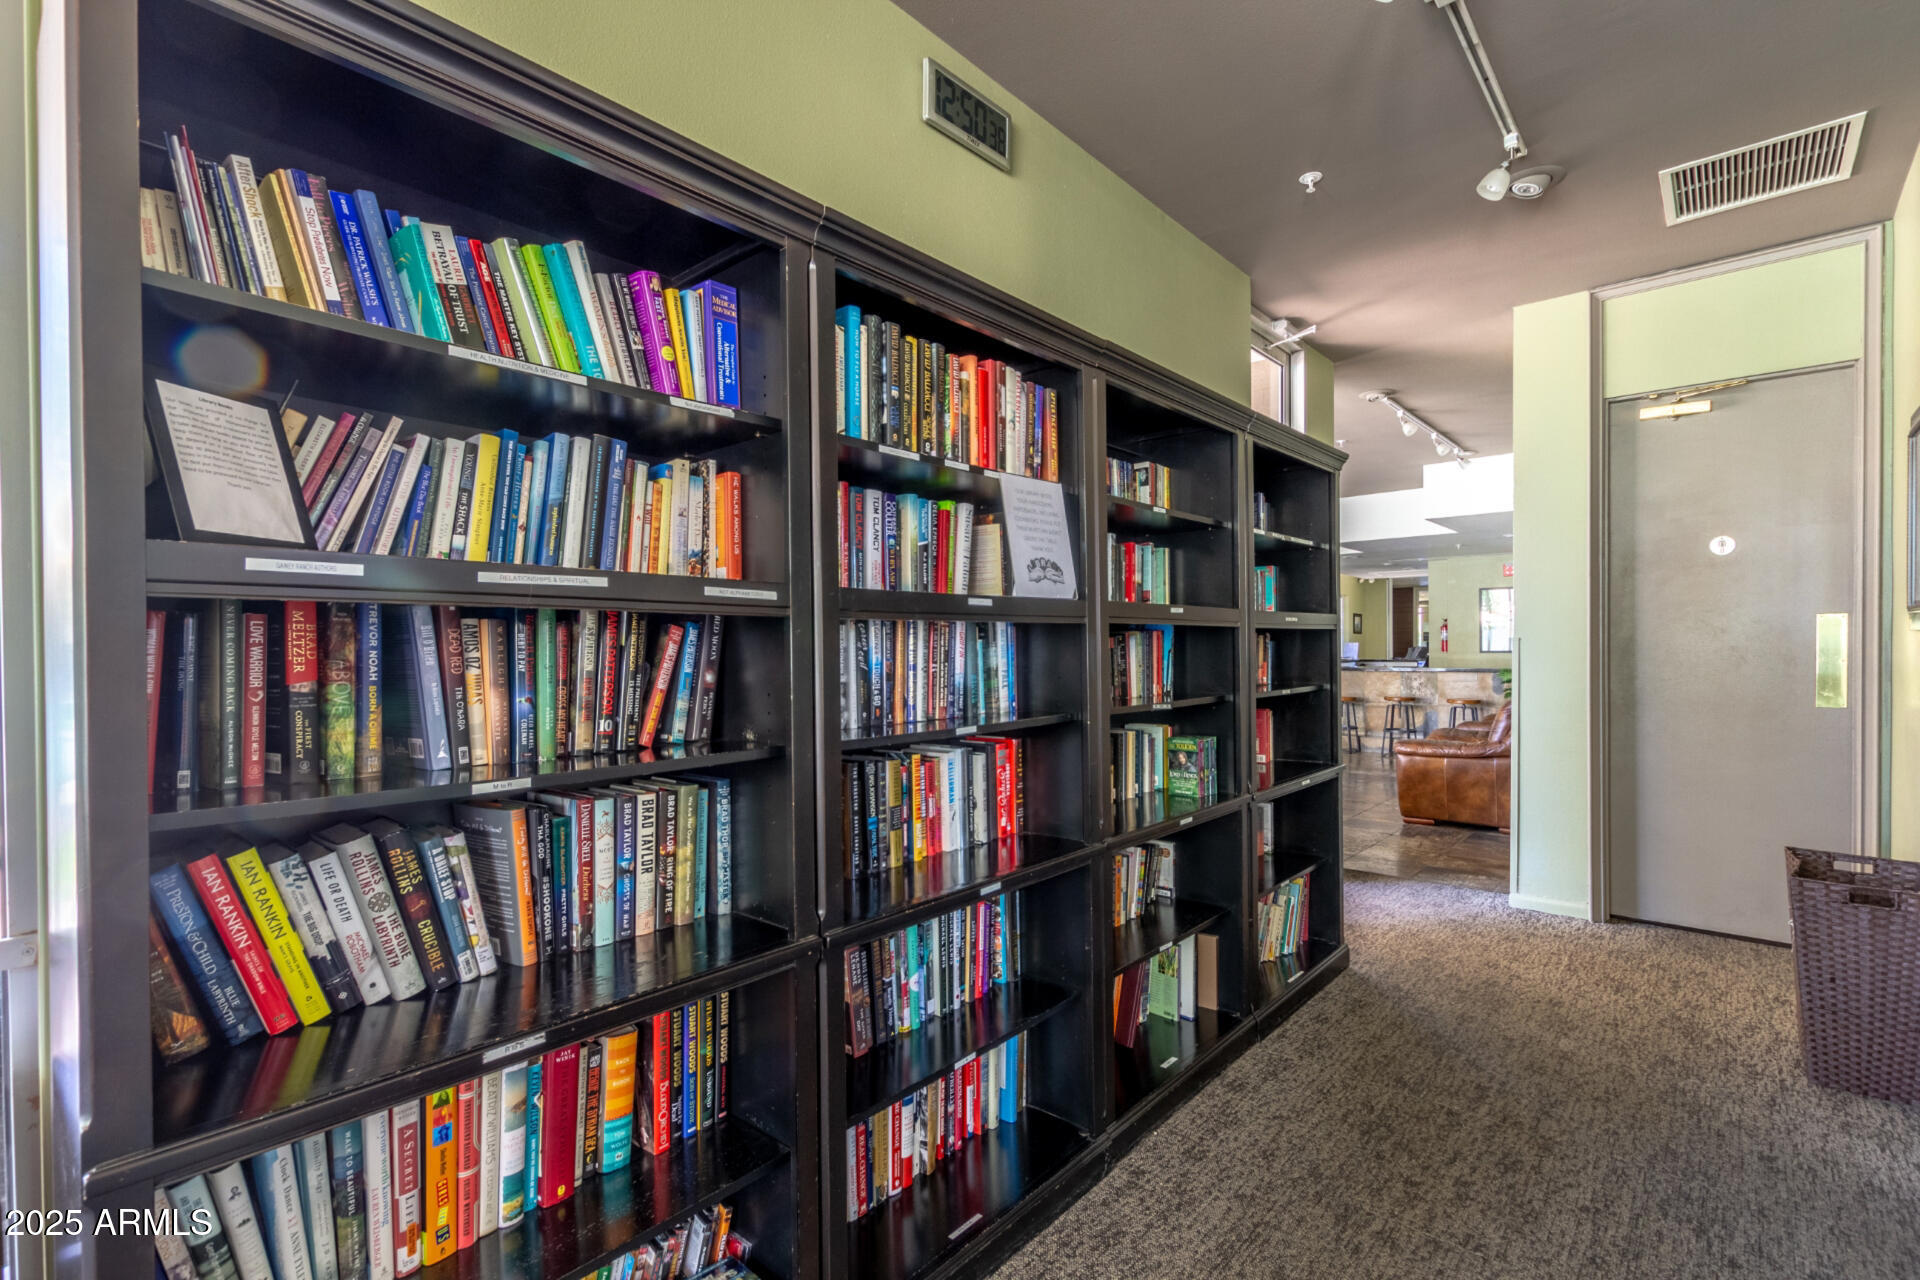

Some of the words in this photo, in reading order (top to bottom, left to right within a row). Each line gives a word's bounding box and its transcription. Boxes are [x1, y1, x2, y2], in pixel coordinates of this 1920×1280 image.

[235, 159, 261, 219] AfterShock
[304, 207, 316, 229] Stop
[321, 265, 333, 289] Now
[353, 236, 368, 269] PATRICK
[360, 270, 379, 307] WALSH'S
[432, 230, 454, 284] BETRAYAL
[452, 299, 469, 335] TRUST
[711, 294, 737, 310] MEDICAL
[711, 304, 738, 318] ADVISOR
[716, 321, 724, 362] Conventional
[469, 351, 498, 364] HEALTH
[499, 358, 533, 372] NUTRITION
[539, 366, 570, 380] MEDICINE
[723, 341, 731, 377] Alternative
[891, 349, 899, 386] BALDACCI
[718, 363, 726, 401] Treatments
[924, 370, 932, 412] BALDACCI
[464, 452, 475, 481] YOUNG
[732, 488, 740, 515] WALKS
[856, 494, 864, 513] TOM
[872, 496, 880, 515] TOM
[884, 500, 892, 536] COULTER
[456, 504, 469, 536] SHACK
[733, 517, 741, 543] AMONG
[856, 514, 864, 550] CLANCY
[872, 516, 880, 553] CLANCY
[499, 574, 553, 584] RELATIONSHIPS
[558, 577, 590, 586] SPIRITUAL
[224, 605, 235, 639] NEVER
[249, 620, 264, 644] LOVE
[368, 602, 378, 648] TREVOR
[462, 623, 481, 653] AMOS
[605, 611, 619, 648] JAMES
[291, 610, 305, 673] MELTZER
[304, 623, 316, 660] BRAD
[517, 633, 526, 650] DEBT
[224, 642, 236, 684] COMING
[248, 645, 264, 689] WARRIOR
[368, 650, 378, 681] NOAH
[465, 655, 482, 670] OZ
[496, 625, 505, 693] WARLIGHT
[602, 648, 618, 716] PATTERSON
[873, 663, 881, 690] TOUCH
[225, 686, 236, 712] BACK
[368, 685, 377, 709] BORN
[633, 687, 641, 722] PRESIDENT
[294, 710, 304, 759] CONSPIRACY
[367, 718, 377, 750] CRIME
[599, 719, 613, 732] 10
[580, 803, 592, 839] DANIELLE
[623, 803, 632, 826] BRAD
[641, 798, 655, 830] BRAD
[667, 795, 675, 818] BRAD
[721, 798, 729, 823] BRAD
[581, 840, 591, 862] STEEL
[623, 828, 631, 859] TAYLOR
[666, 820, 675, 852] TAYLOR
[721, 824, 729, 849] THOR
[363, 852, 385, 886] JAMES
[402, 850, 423, 885] JAMES
[434, 856, 450, 881] BRIEF
[640, 833, 654, 875] TAYLOR
[320, 862, 334, 882] LIFE
[349, 852, 376, 896] ROLLINS
[388, 848, 413, 896] ROLLINS
[582, 866, 592, 901] Duchess
[240, 860, 262, 886] IAN
[252, 887, 287, 941] RANKIN
[328, 883, 342, 897] OR
[441, 879, 457, 901] STOP
[200, 866, 225, 894] IAN
[214, 895, 252, 949] RANKIN
[333, 896, 353, 923] DEATH
[387, 912, 402, 932] THE
[344, 934, 366, 974] ROBOTHAM
[353, 931, 372, 962] MICHAEL
[371, 915, 401, 969] LABYRINTH
[393, 931, 412, 961] BONE
[417, 919, 445, 973] CRUCIBLE
[850, 953, 858, 987] LEHANE
[207, 978, 237, 1026] LABYRINTH
[222, 984, 241, 1008] BLUE
[720, 991, 729, 1026] STUART
[673, 1009, 682, 1048] STUART
[688, 1004, 697, 1038] STUART
[705, 1000, 713, 1033] STUART
[560, 1049, 572, 1058] JAY
[615, 1056, 631, 1067] BACK
[688, 1040, 697, 1074] WOODS
[705, 1034, 713, 1067] WOODS
[720, 1026, 729, 1064] WOODS
[612, 1077, 632, 1088] BLOOD
[673, 1050, 682, 1088] WOODS
[487, 1077, 498, 1116] BEATRIZ
[345, 1130, 353, 1154] WALK
[380, 1113, 389, 1156] everyone
[486, 1117, 497, 1165] WILLIAMS
[279, 1157, 291, 1184] Clock
[381, 1156, 390, 1186] worth
[859, 1160, 867, 1199] CHANGE
[283, 1185, 293, 1214] Dance
[346, 1170, 354, 1216] BEAUTIFUL
[382, 1185, 391, 1228] knowing
